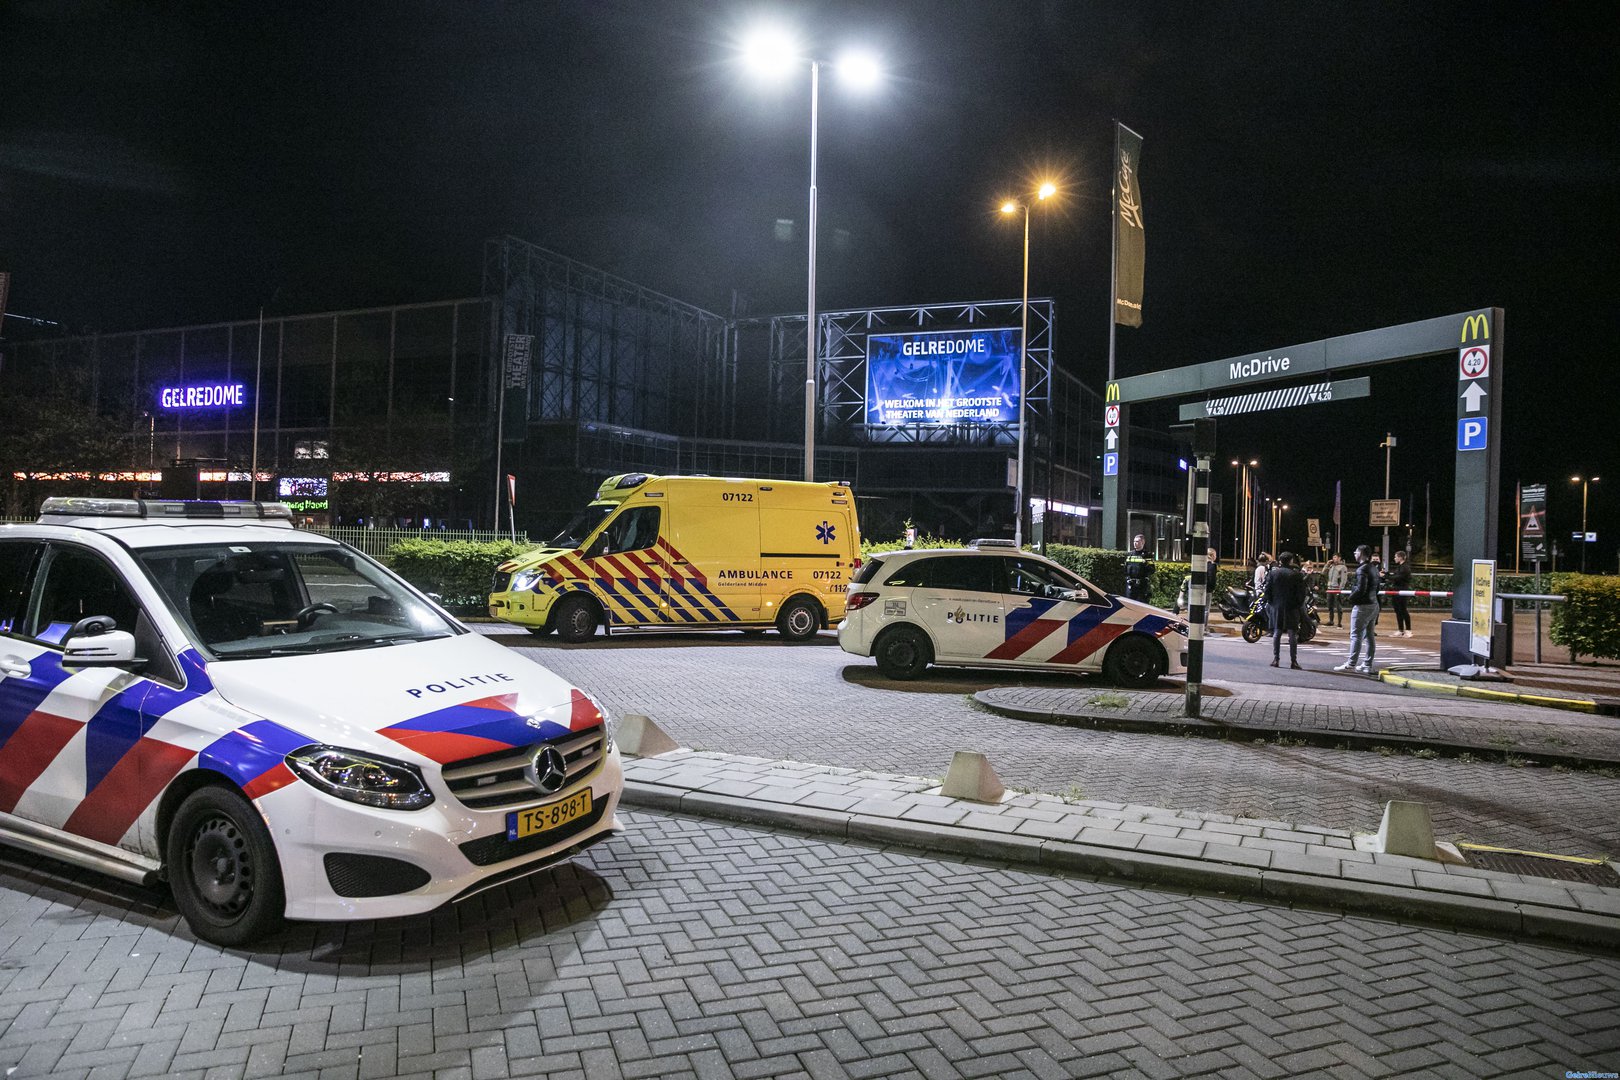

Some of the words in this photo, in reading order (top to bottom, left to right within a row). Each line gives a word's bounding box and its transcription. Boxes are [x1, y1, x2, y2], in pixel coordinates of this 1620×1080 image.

[903, 339, 985, 356] GELREDOME
[511, 336, 526, 387] THEATER
[1230, 356, 1290, 379] McDrive
[1467, 358, 1481, 367] 4.20
[162, 385, 243, 408] GELREDOME
[1317, 391, 1332, 401] 4.20
[884, 400, 923, 409] WELKOM
[926, 399, 935, 408] IN
[938, 398, 954, 407] HET
[957, 397, 1002, 407] GROOTSTE
[885, 410, 924, 419] THEATER
[926, 410, 944, 419] VAN
[946, 408, 1000, 418] NEDERLAND
[1212, 406, 1224, 415] 4.20
[1464, 422, 1481, 446] P
[1107, 456, 1116, 472] P
[722, 493, 753, 502] 07122
[718, 570, 793, 579] AMBULANCE
[813, 571, 841, 579] 07122
[947, 611, 999, 624] POLITIE
[406, 673, 514, 698] POLITIE
[523, 793, 587, 832] TS-898-T
[509, 828, 517, 836] NL
